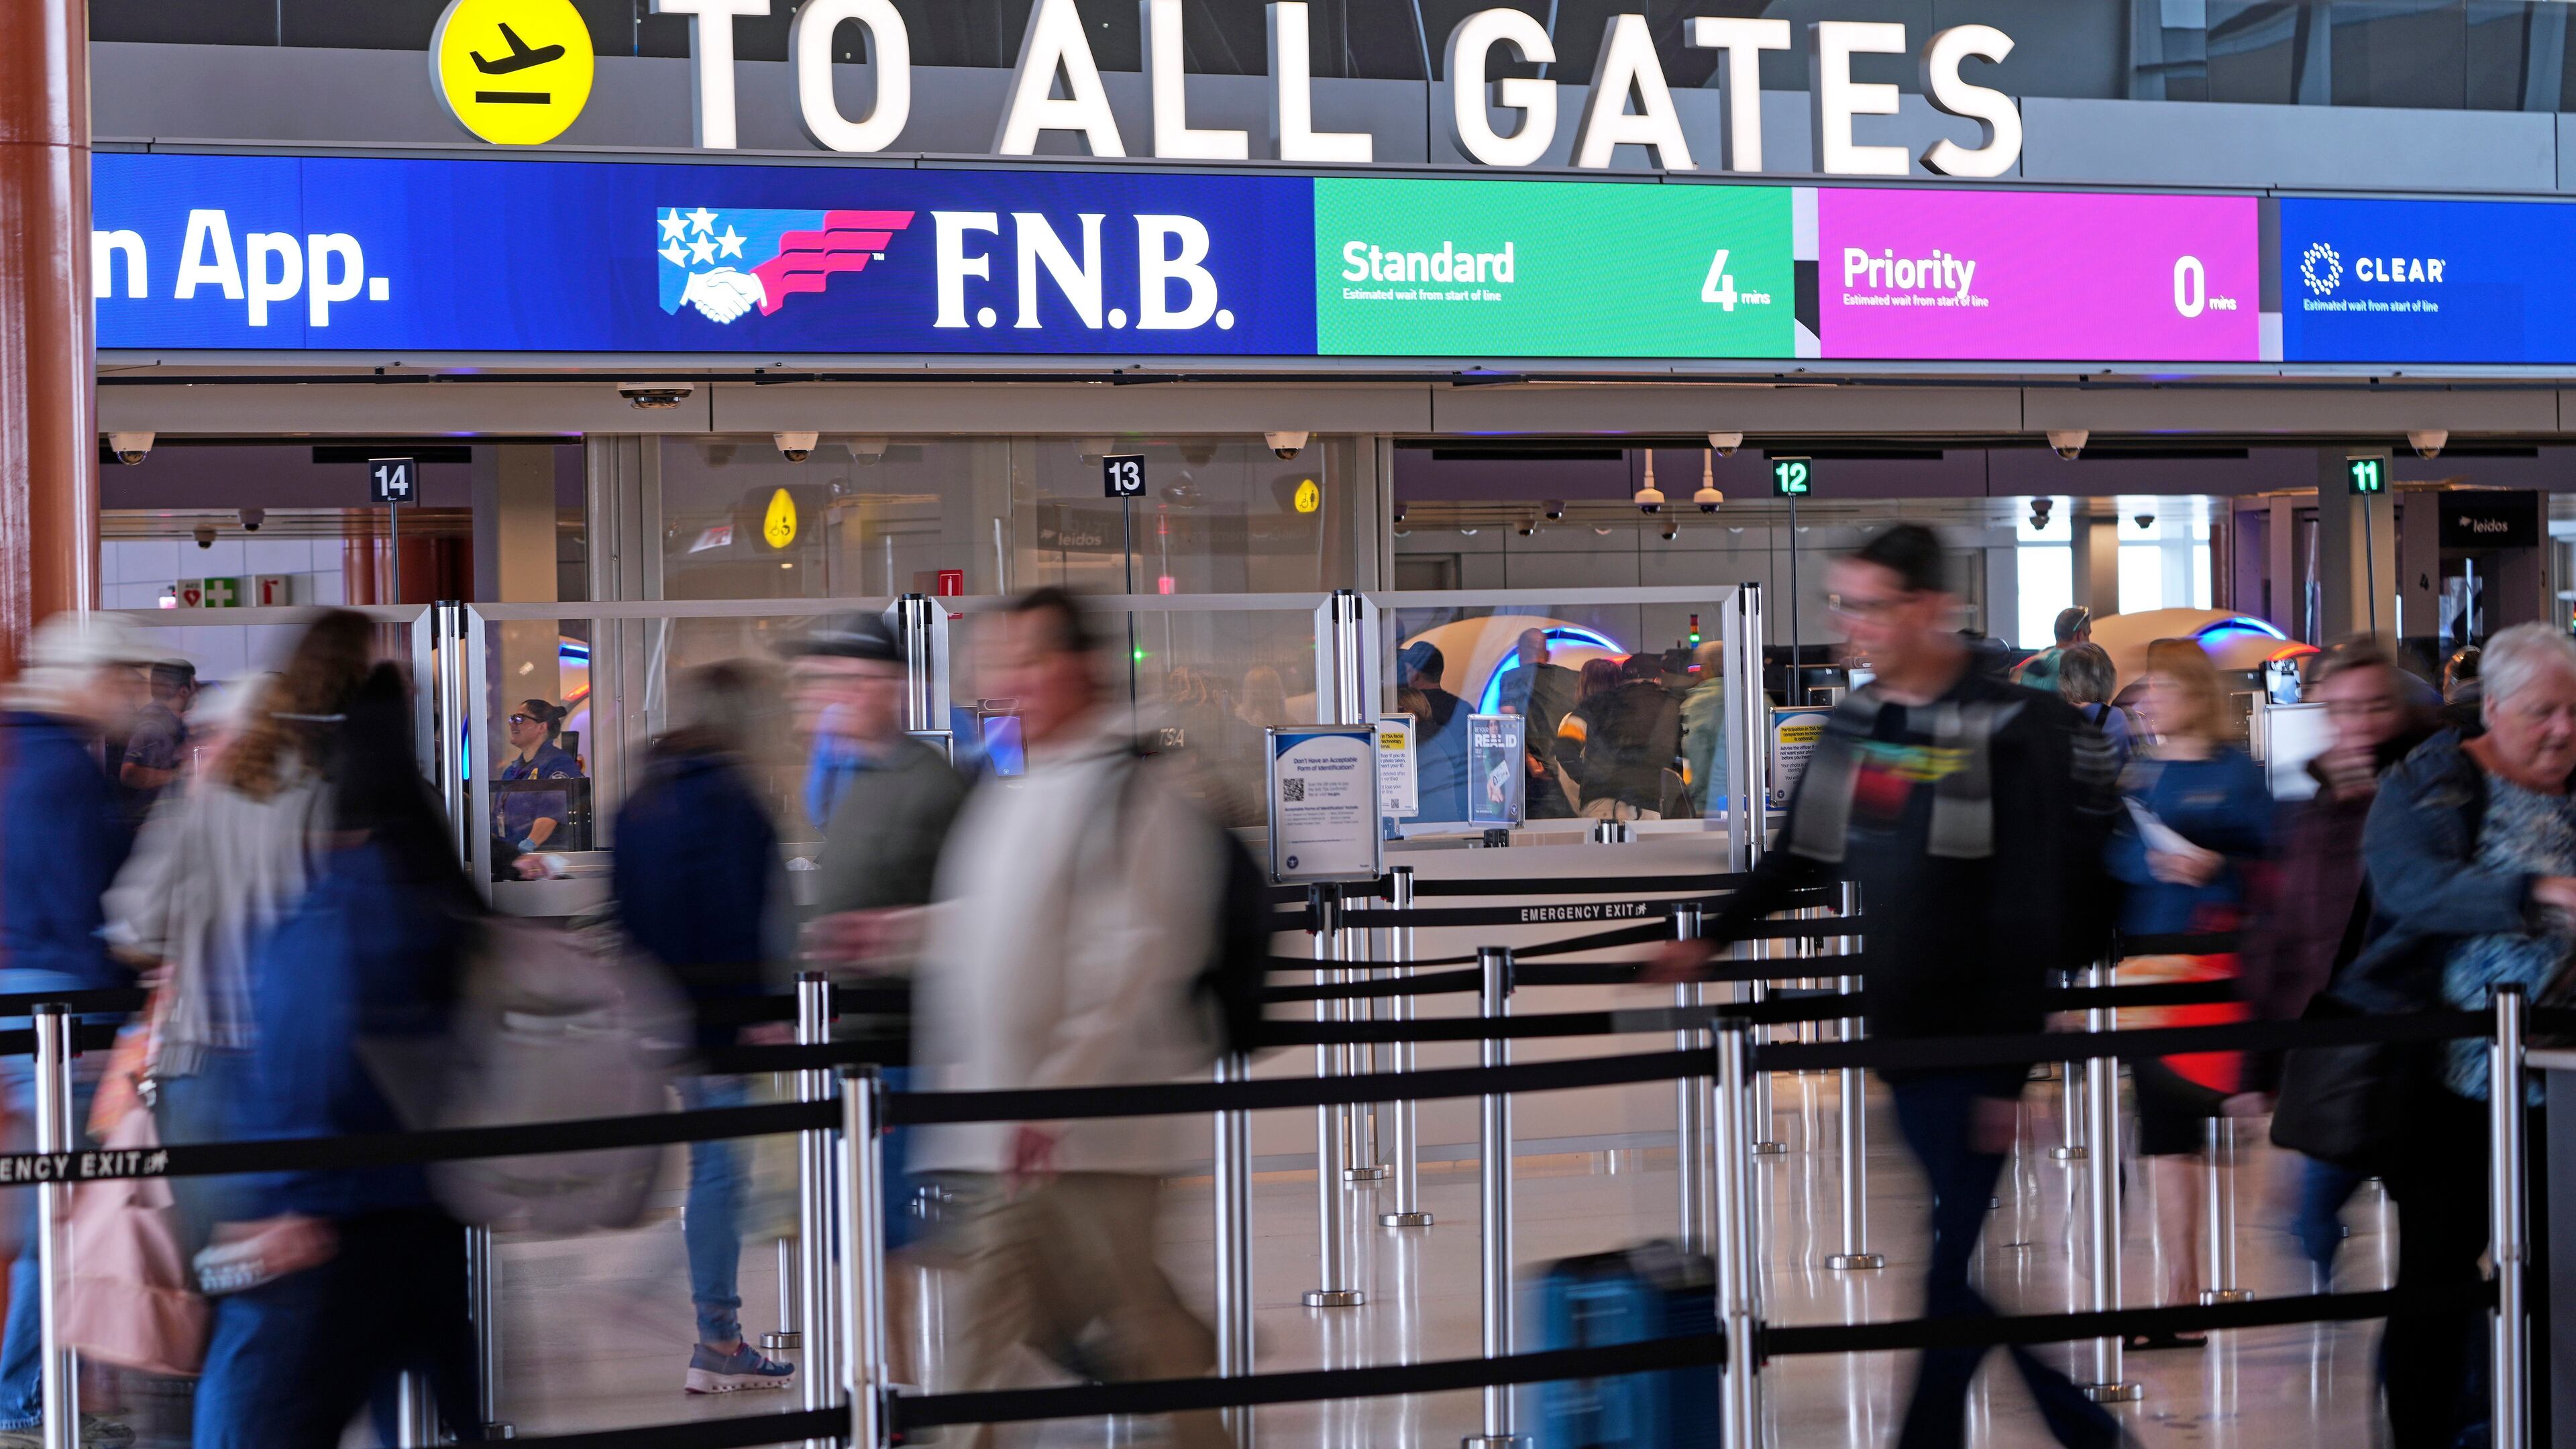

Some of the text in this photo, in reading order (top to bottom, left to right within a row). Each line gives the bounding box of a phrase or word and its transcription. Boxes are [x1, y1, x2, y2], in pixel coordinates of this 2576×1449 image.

[651, 0, 2022, 176] TO ALL GATES
[174, 209, 390, 327] App.
[930, 210, 1234, 331] F.N.B.
[1342, 240, 1514, 283] Standard
[1844, 247, 1976, 300] Priority
[2355, 257, 2443, 282] CLEAR
[1343, 288, 1502, 301] Estimated wait from start of line
[1701, 249, 1771, 312] 4 mins
[2174, 255, 2237, 318] 0 mins
[1843, 293, 1989, 307] Estimated wait from start of line
[2303, 299, 2438, 312] Estimated wait from start of line
[374, 465, 409, 496] 14
[1108, 461, 1140, 491] 13
[1776, 462, 1807, 492] 12
[2352, 461, 2377, 490] 11
[1058, 532, 1102, 545] leidos
[2473, 518, 2509, 533] leidos
[1159, 728, 1184, 747] TSA
[1475, 734, 1517, 747] REAL ID
[1521, 903, 1633, 922] EMERGENCY EXIT
[80, 1151, 142, 1177] EXIT
